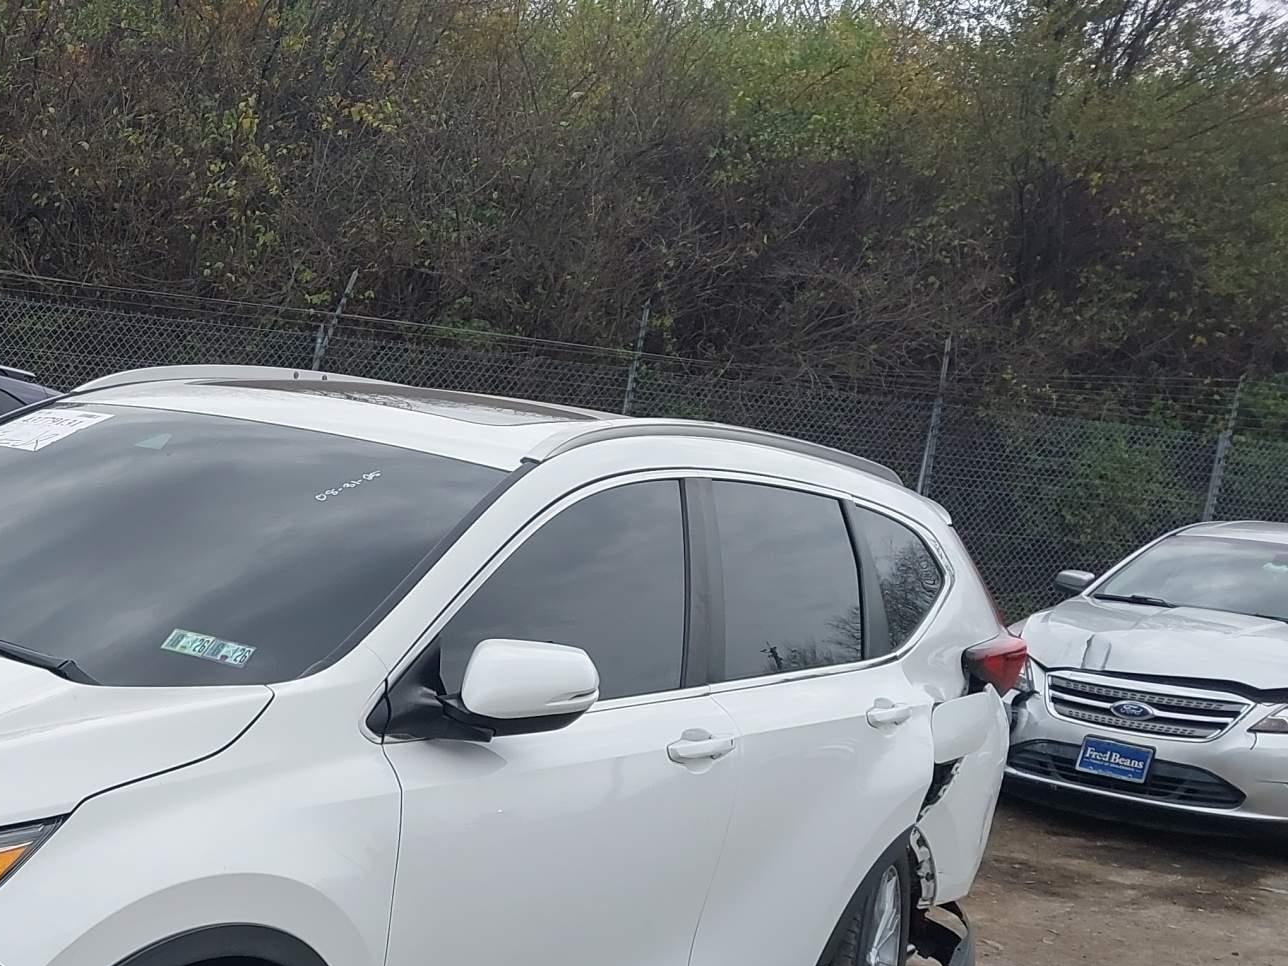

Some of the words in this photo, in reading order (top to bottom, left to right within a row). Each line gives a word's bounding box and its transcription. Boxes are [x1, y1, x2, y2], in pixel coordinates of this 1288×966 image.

[1120, 704, 1143, 716] Ford
[1085, 747, 1111, 761] Fred
[1110, 751, 1145, 769] Beans
